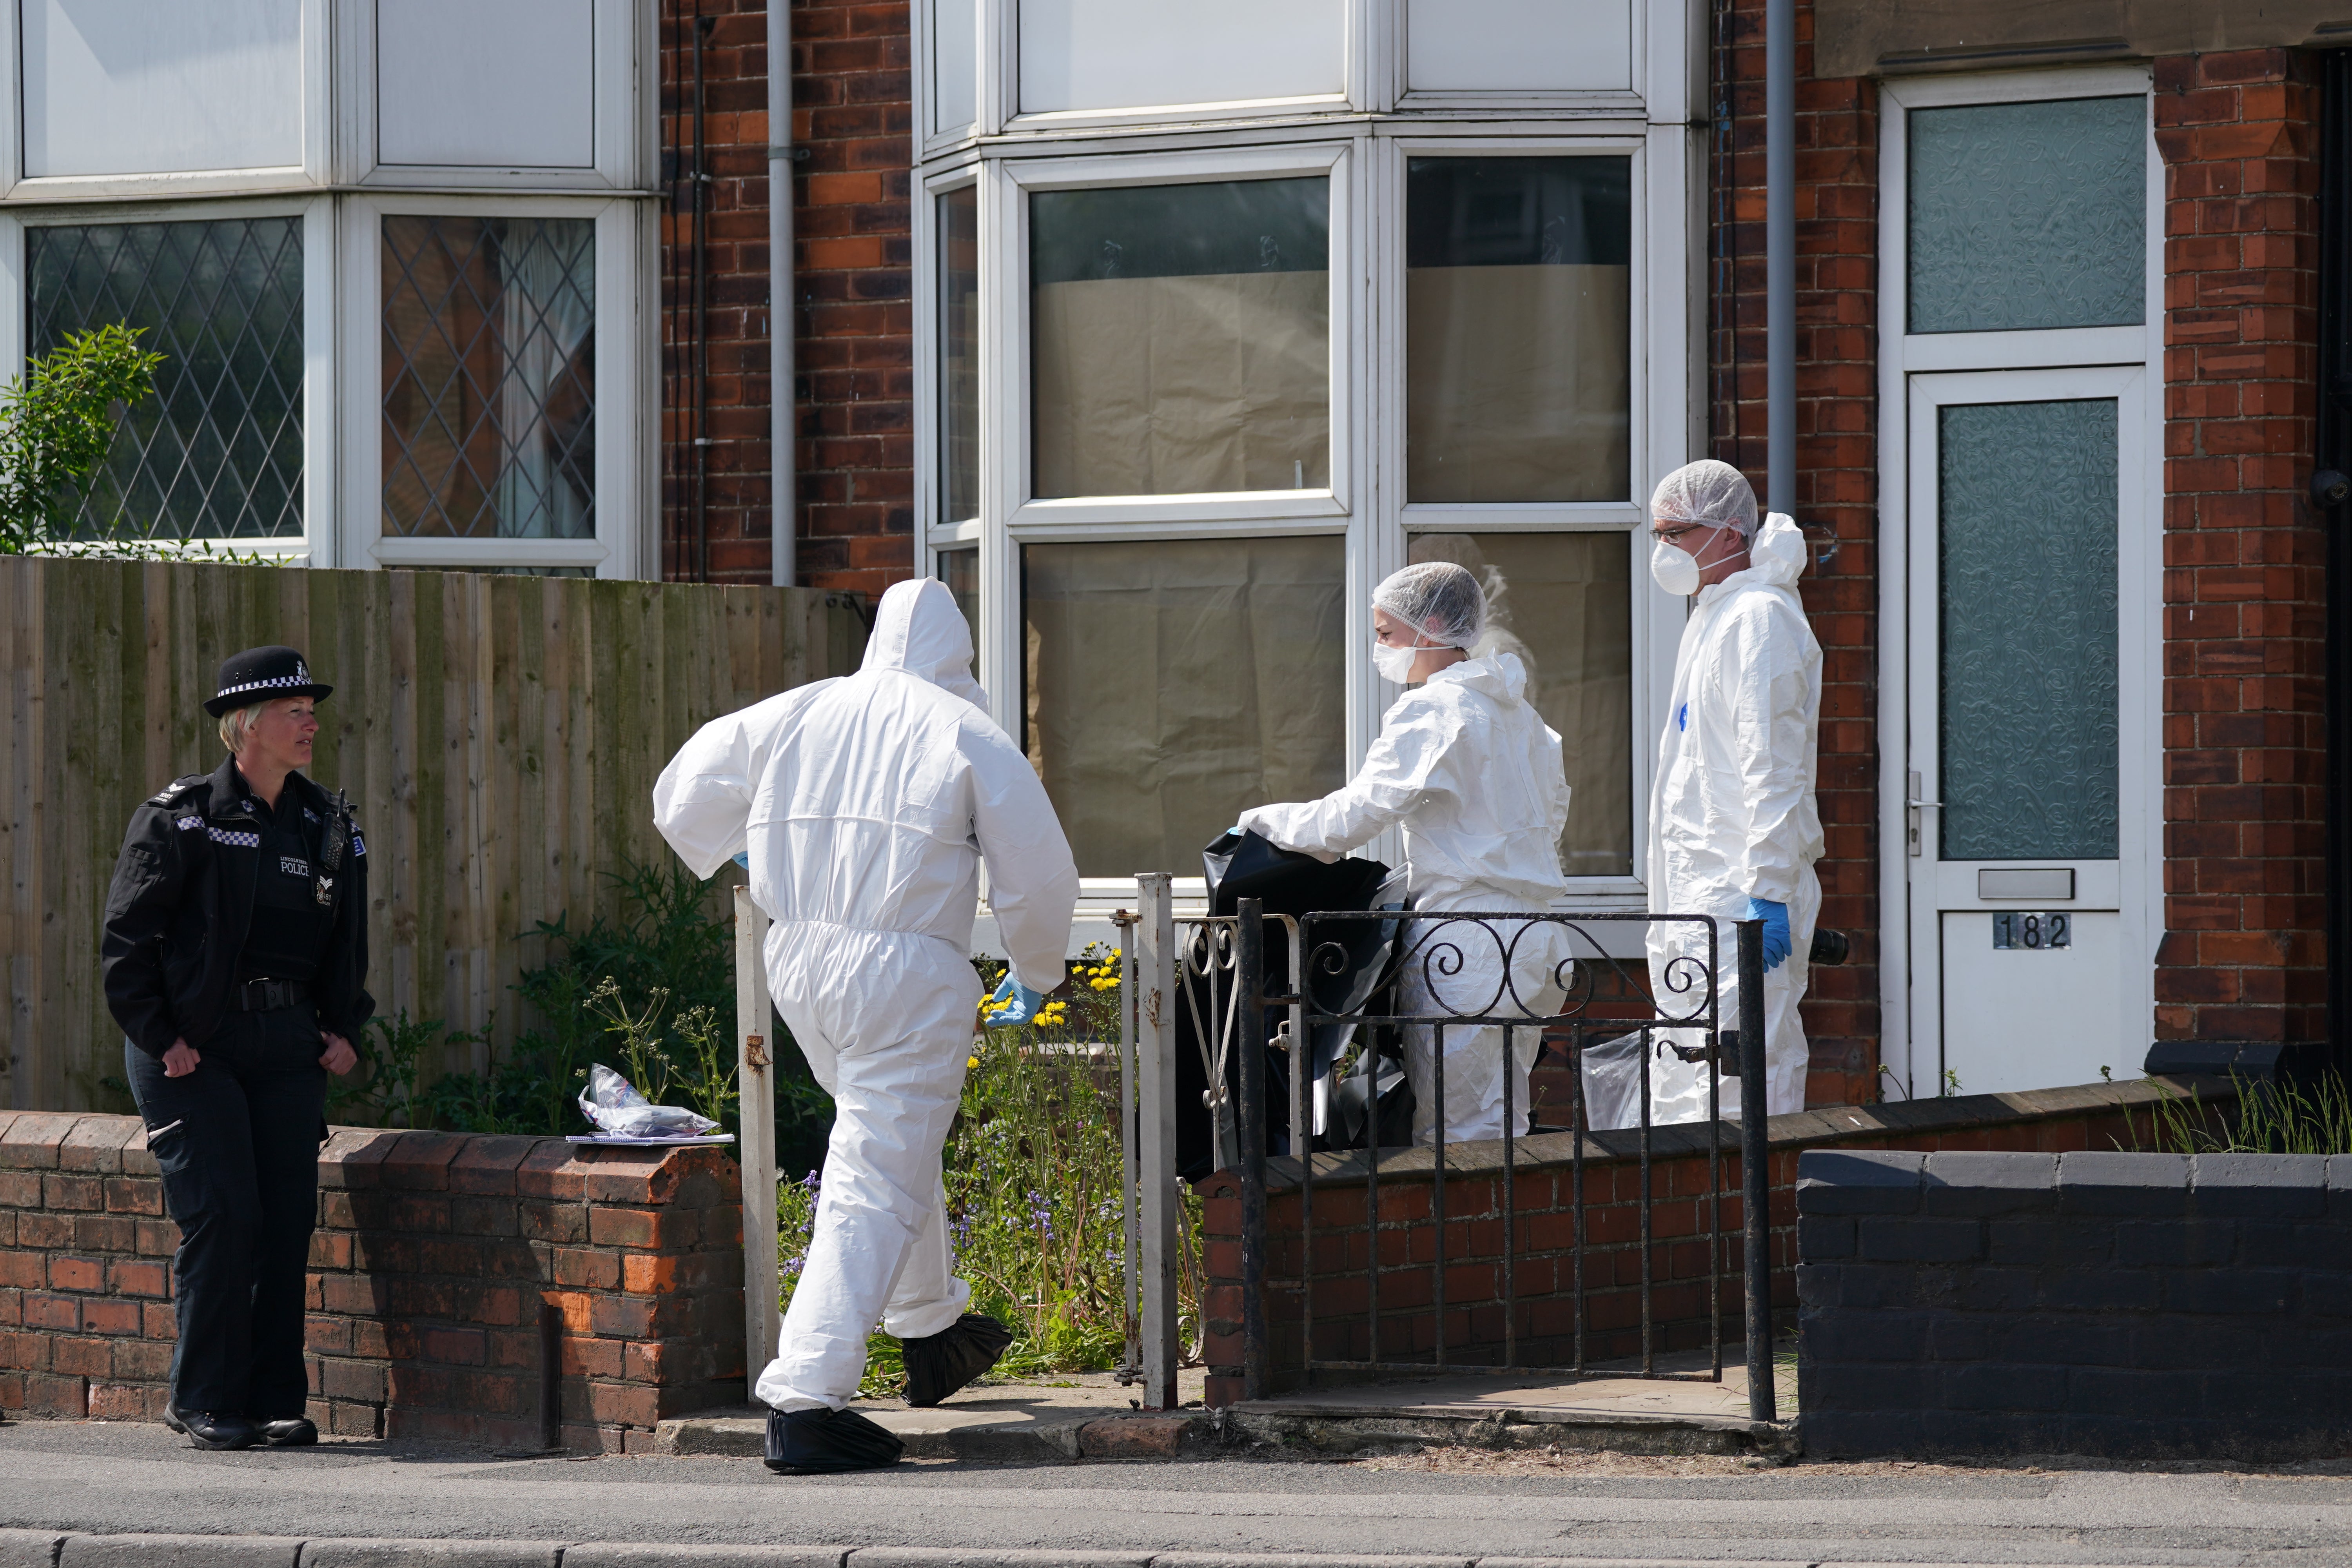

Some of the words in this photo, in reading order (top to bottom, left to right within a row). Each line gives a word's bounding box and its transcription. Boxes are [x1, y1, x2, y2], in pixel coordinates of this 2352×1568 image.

[280, 856, 308, 866] LINCOLNSHIR
[281, 862, 310, 877] POLICE
[2001, 915, 2065, 948] 182
